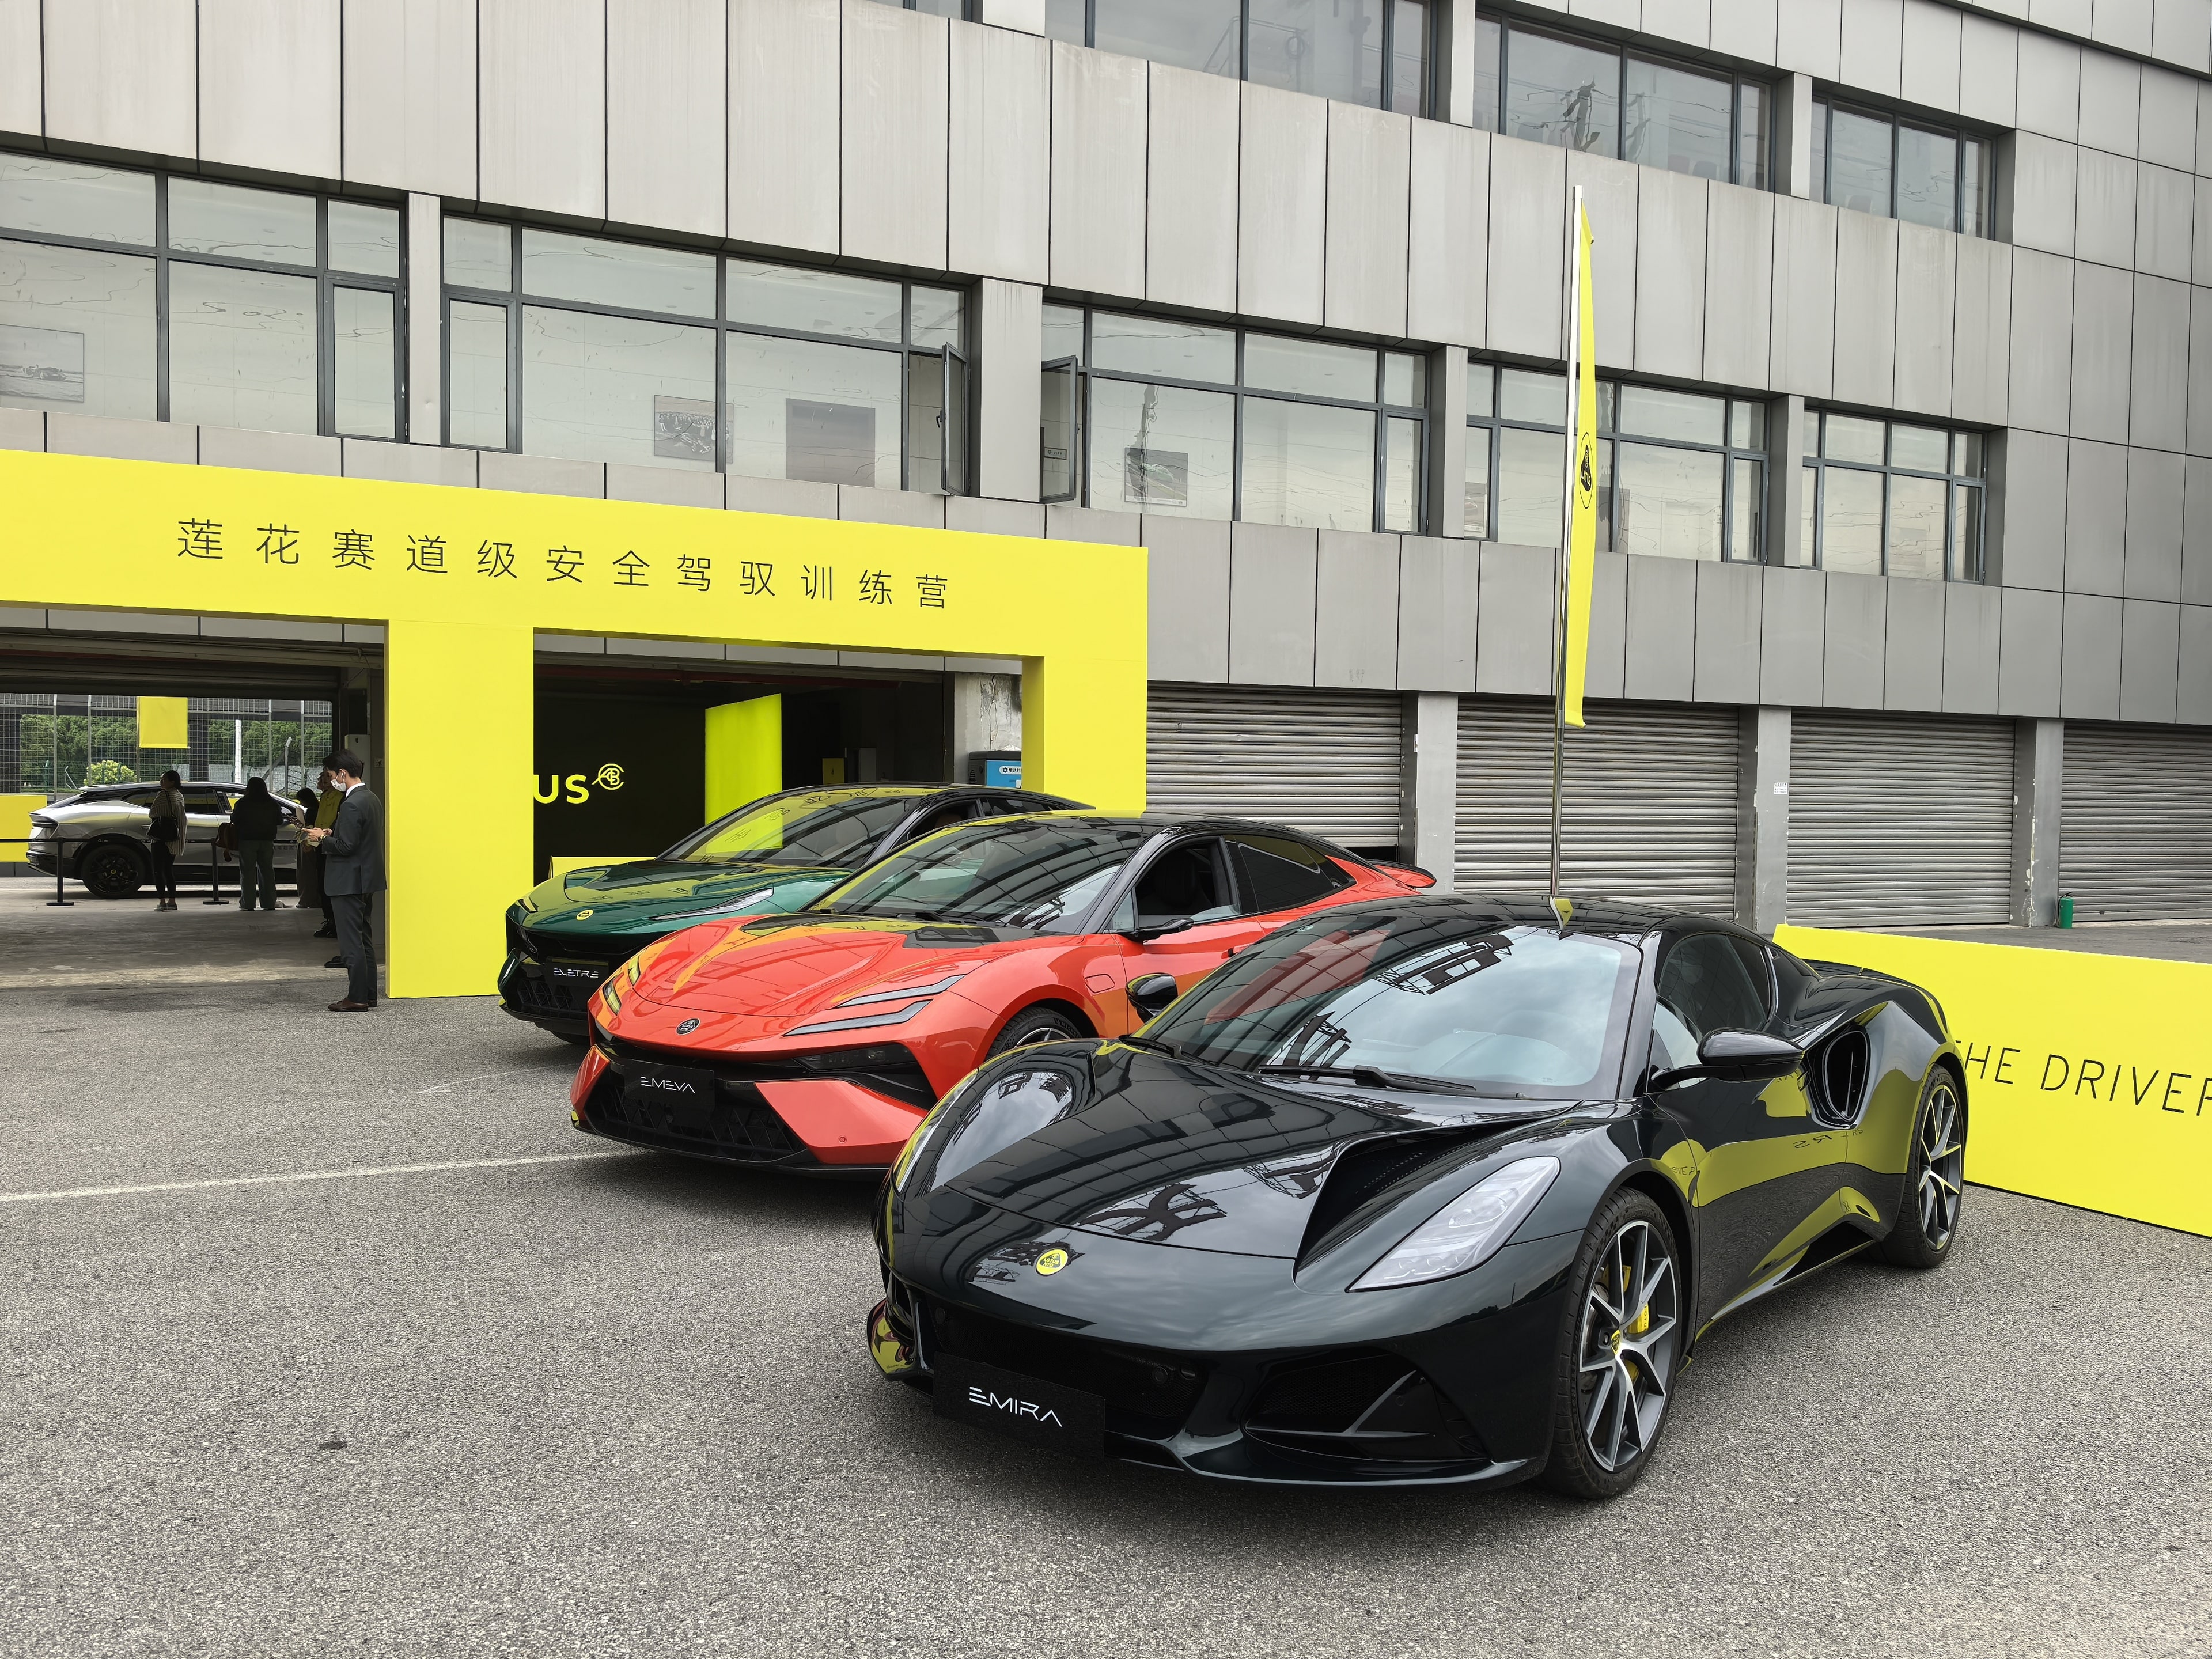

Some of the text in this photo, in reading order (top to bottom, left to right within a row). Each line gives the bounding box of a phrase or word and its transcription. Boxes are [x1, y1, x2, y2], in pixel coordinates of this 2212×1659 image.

[177, 517, 948, 609] 莲花赛道级安全驾驭训练营
[554, 968, 599, 978] ELETRE
[1955, 1040, 2021, 1085] HE
[641, 1076, 695, 1094] EMEYA
[969, 1386, 1063, 1427] EMIRA
